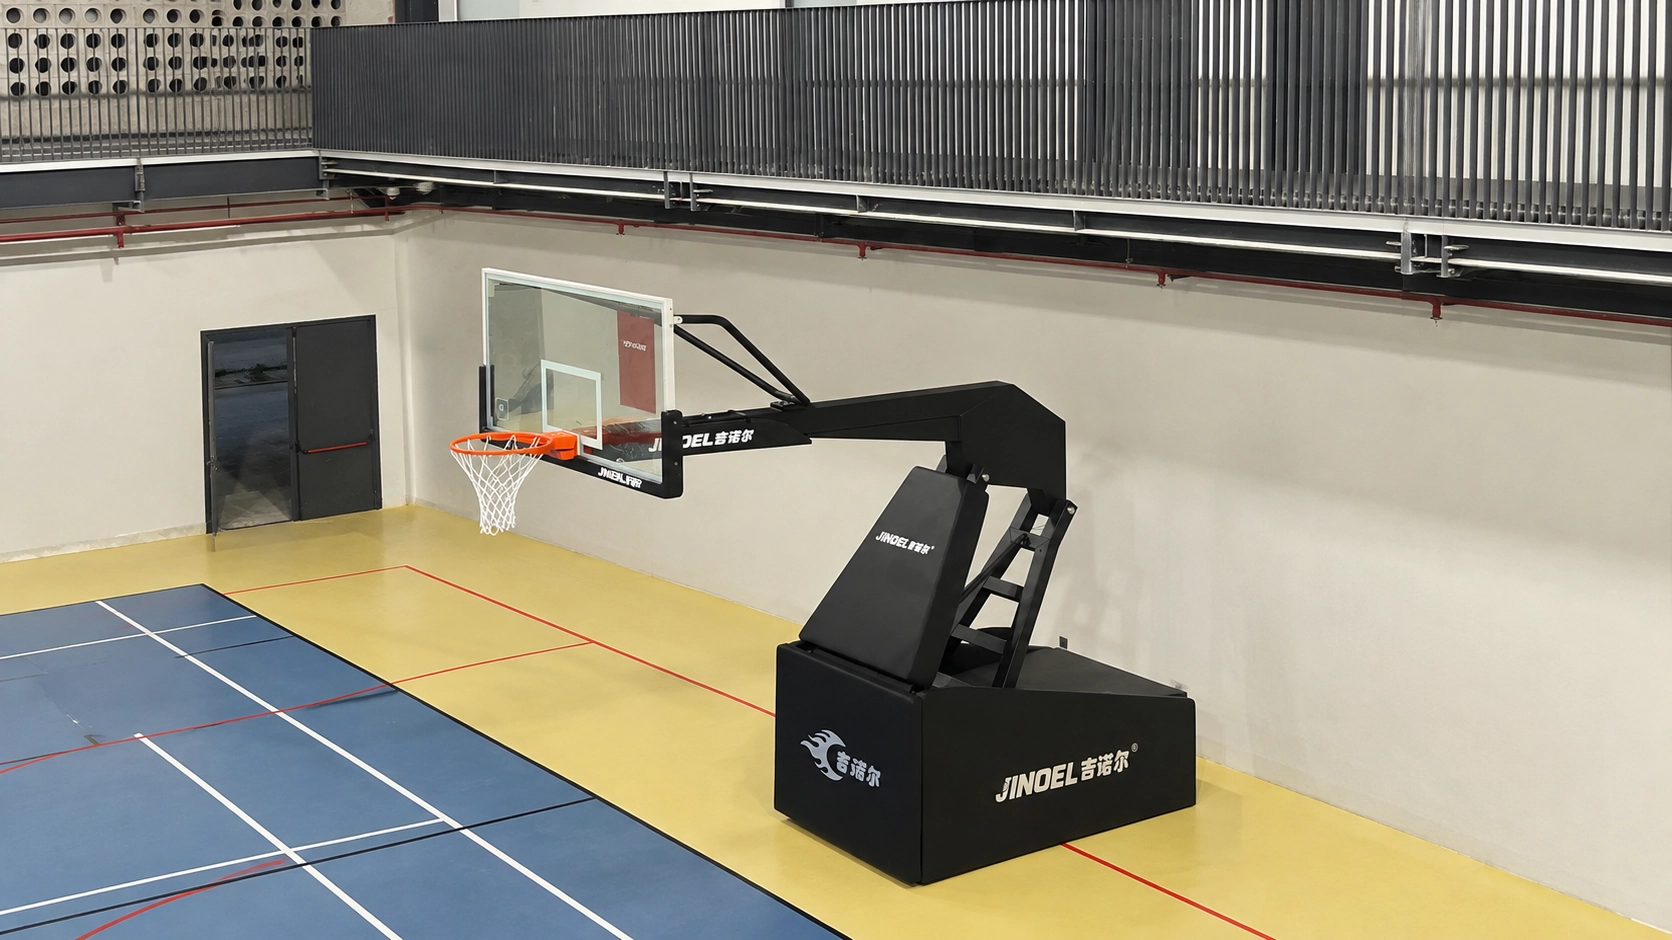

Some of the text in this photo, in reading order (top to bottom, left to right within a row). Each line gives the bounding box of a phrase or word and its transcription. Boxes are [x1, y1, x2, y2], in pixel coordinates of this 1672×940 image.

[875, 531, 909, 549] JINOEL
[837, 751, 881, 787] 吉诺尔
[995, 749, 1130, 803] JINOEL 吉诺尔
